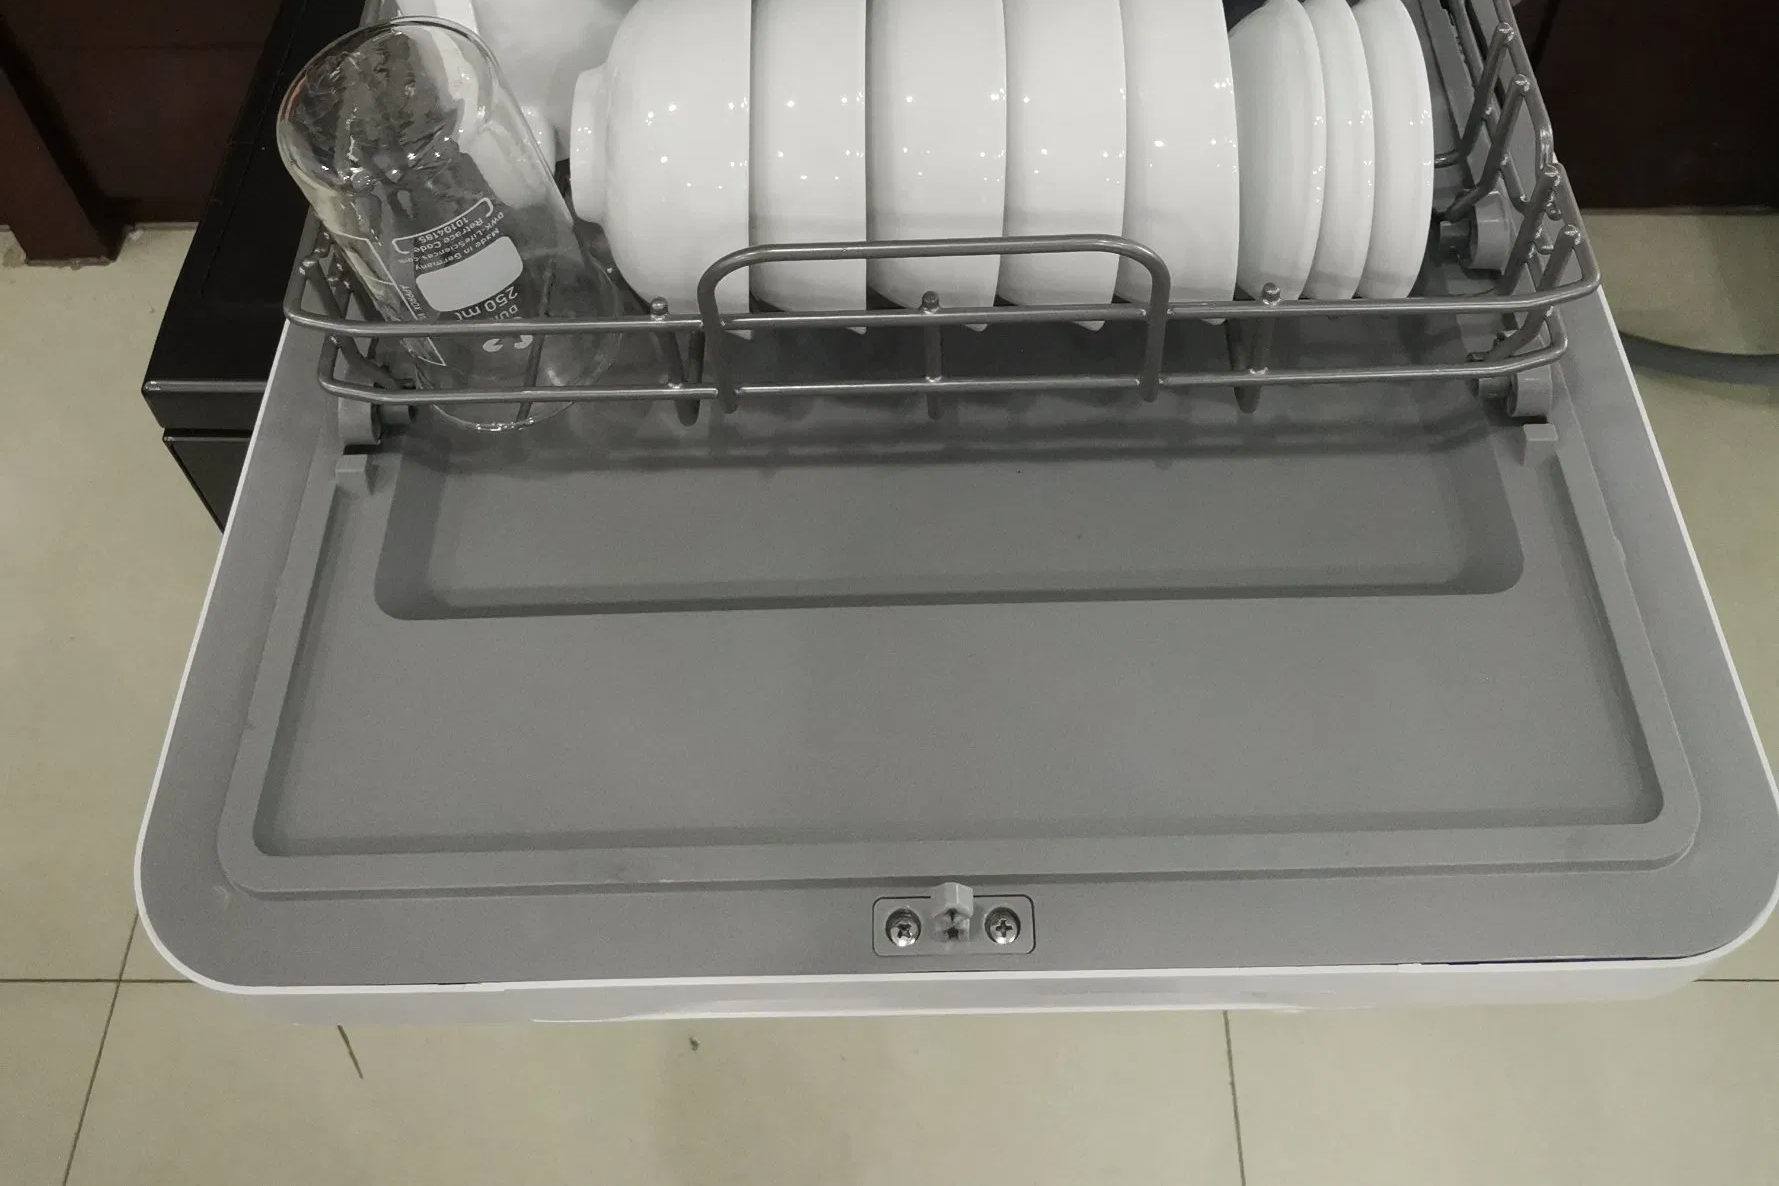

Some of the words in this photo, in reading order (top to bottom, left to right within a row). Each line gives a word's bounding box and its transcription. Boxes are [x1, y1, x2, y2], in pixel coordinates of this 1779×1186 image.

[443, 217, 483, 244] Retrace
[475, 227, 500, 249] Made
[413, 241, 442, 253] Code
[463, 246, 474, 255] in
[415, 252, 463, 271] Germany
[484, 286, 519, 312] 250
[455, 305, 482, 321] ml
